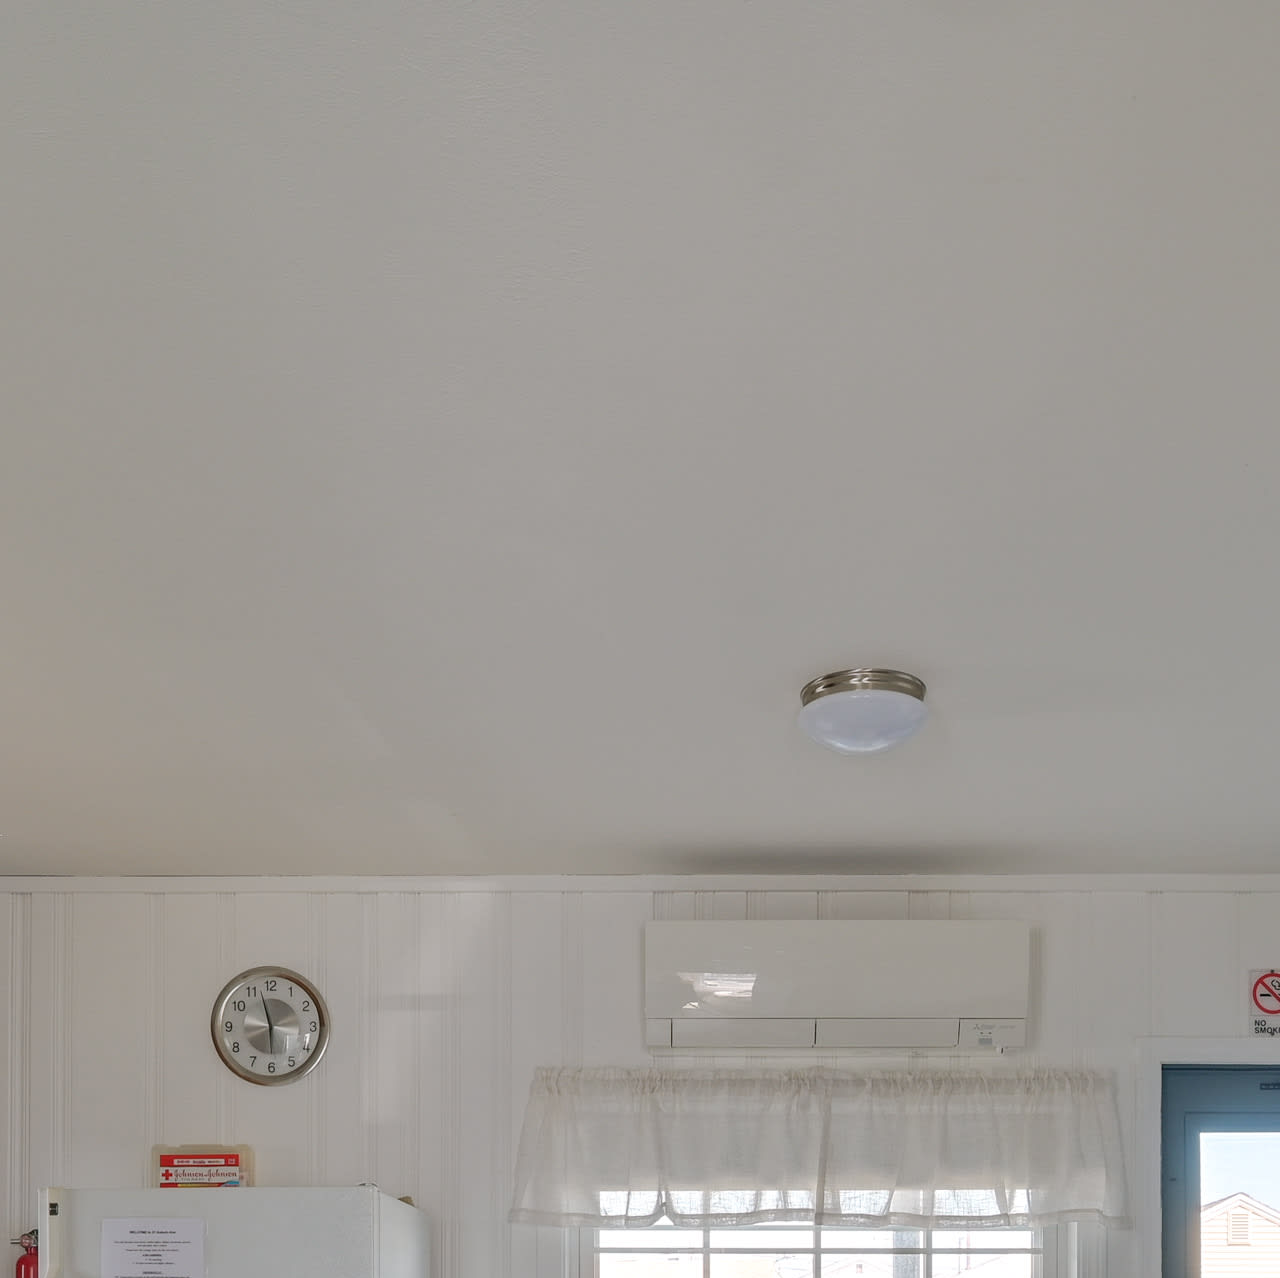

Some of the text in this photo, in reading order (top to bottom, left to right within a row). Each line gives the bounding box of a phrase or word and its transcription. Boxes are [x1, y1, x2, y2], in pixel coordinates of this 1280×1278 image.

[246, 986, 257, 998] 11
[265, 980, 277, 992] 12
[288, 986, 293, 998] 1
[233, 1000, 246, 1012] 10
[302, 1000, 310, 1012] 2
[225, 1021, 233, 1033] 9
[309, 1021, 317, 1033] 3
[232, 1042, 240, 1053] 8
[250, 1056, 257, 1067] 7
[268, 1062, 276, 1073] 6
[288, 1056, 296, 1067] 5
